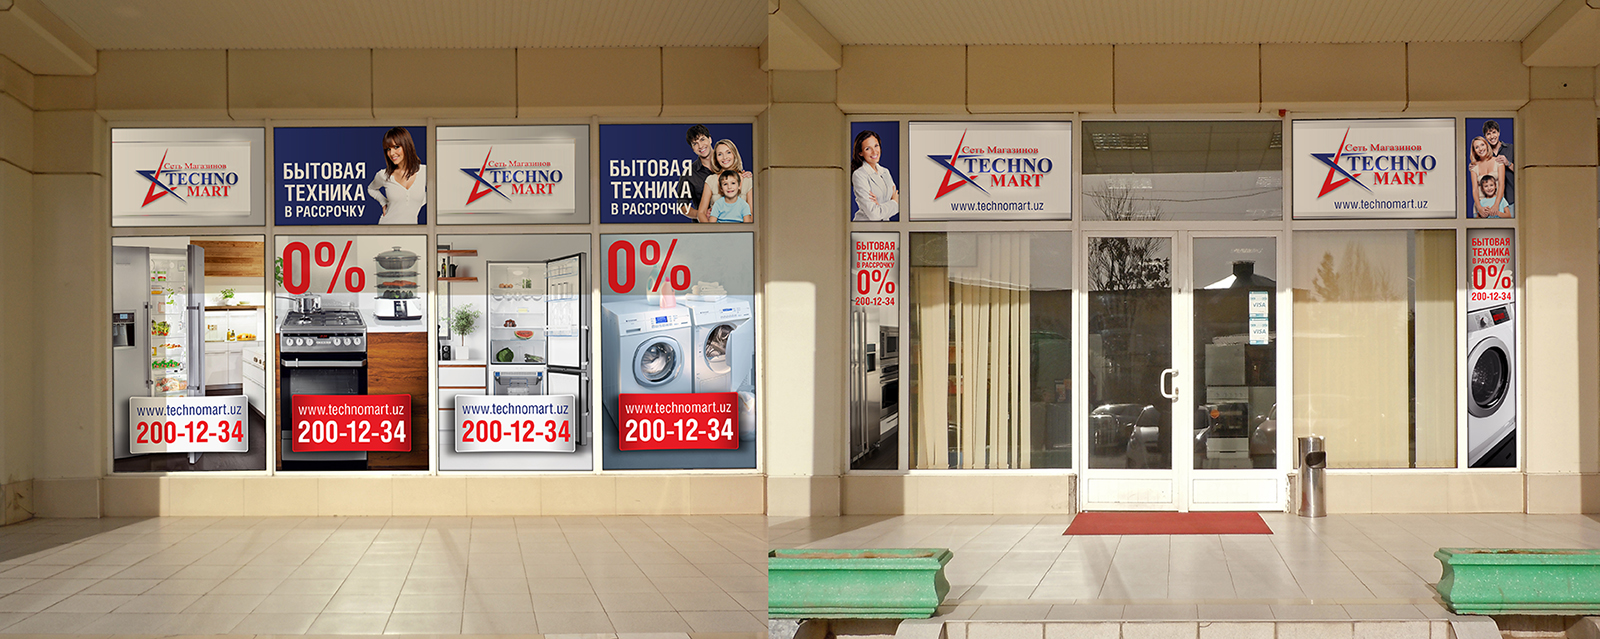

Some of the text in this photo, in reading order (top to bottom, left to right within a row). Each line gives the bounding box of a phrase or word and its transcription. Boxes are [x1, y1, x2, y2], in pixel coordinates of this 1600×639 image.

[962, 146, 1039, 154] Сеть Магазинов
[1345, 144, 1422, 152] Сеть Магазинов
[164, 162, 227, 170] Сеть Магазинов
[609, 159, 692, 177] БЫТОВАЯ
[964, 158, 1053, 174] TECHNO
[1347, 155, 1436, 171] TECHNO
[283, 162, 366, 179] БЫТОВАЯ
[490, 170, 563, 183] TECHNO
[165, 172, 239, 185] TECHNO
[991, 174, 1044, 187] MART
[1374, 172, 1427, 185] MART
[187, 186, 231, 197] MART
[284, 184, 365, 201] ТЕХНИКА
[511, 183, 556, 195] MART
[611, 181, 692, 199] ТЕХНИКА
[285, 205, 365, 217] В РАССРОЧКУ
[611, 202, 692, 215] В РАССРОЧКУ
[951, 201, 1044, 211] www.technomart.uz
[1334, 199, 1428, 210] www.technomart.uz
[856, 241, 895, 250] БЫТОВАЯ
[1472, 238, 1510, 246] БЫТОВАЯ
[857, 252, 895, 261] ТЕХНИКА
[1472, 248, 1510, 256] ТЕХНИКА
[282, 240, 366, 295] 0%
[608, 238, 691, 294] 0%
[857, 269, 895, 295] 0%
[1473, 264, 1511, 290] 0%
[855, 297, 895, 305] 200-12-34
[1472, 292, 1511, 301] 200-12-34
[137, 404, 242, 417] www.technomart.uz
[298, 403, 404, 416] www.technomart.uz
[462, 403, 569, 415] www.technomart.uz
[625, 401, 732, 414] www.technomart.uz
[136, 420, 244, 444] 200-12-34
[298, 420, 407, 443] 200-12-34
[462, 419, 571, 443] 200-12-34
[625, 417, 734, 442] 200-12-34
